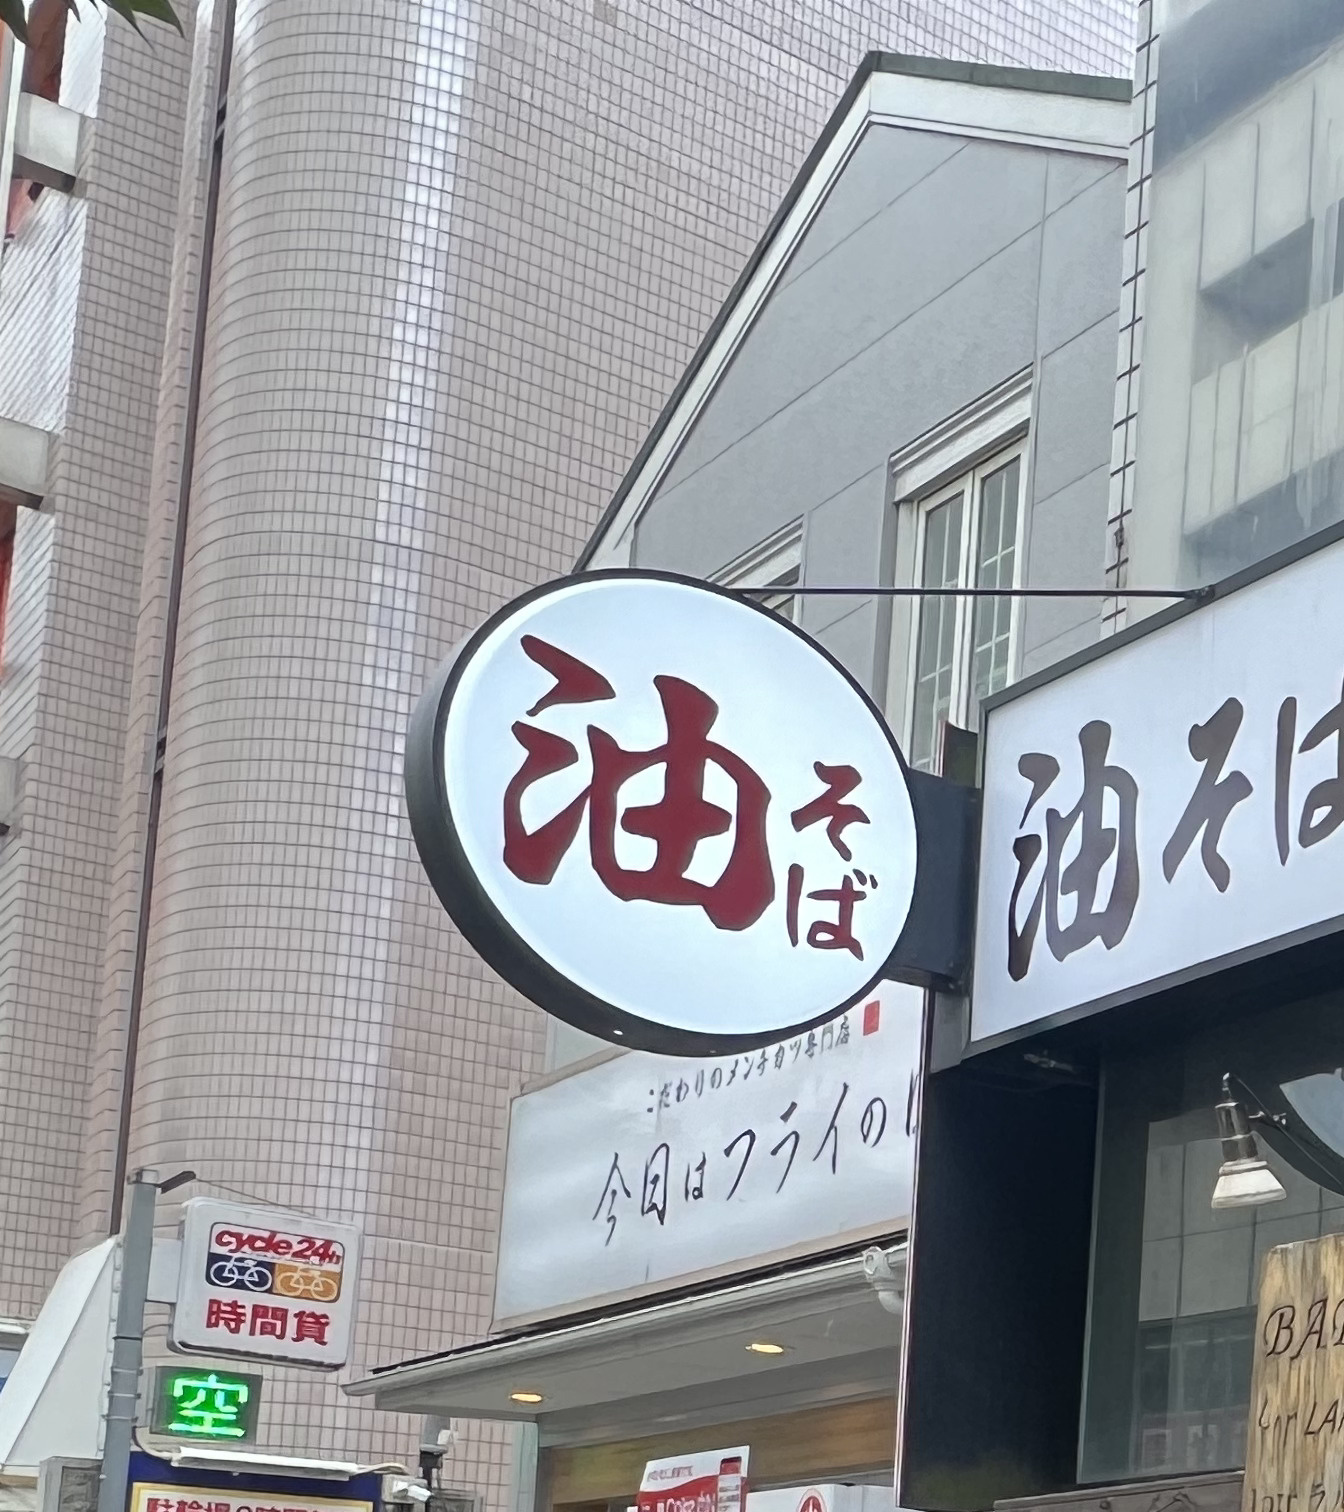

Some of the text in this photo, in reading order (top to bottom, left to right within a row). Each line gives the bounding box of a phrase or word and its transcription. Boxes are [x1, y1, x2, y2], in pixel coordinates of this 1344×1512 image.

[206, 1299, 331, 1346] 時間貸
[168, 1374, 249, 1437] 空
